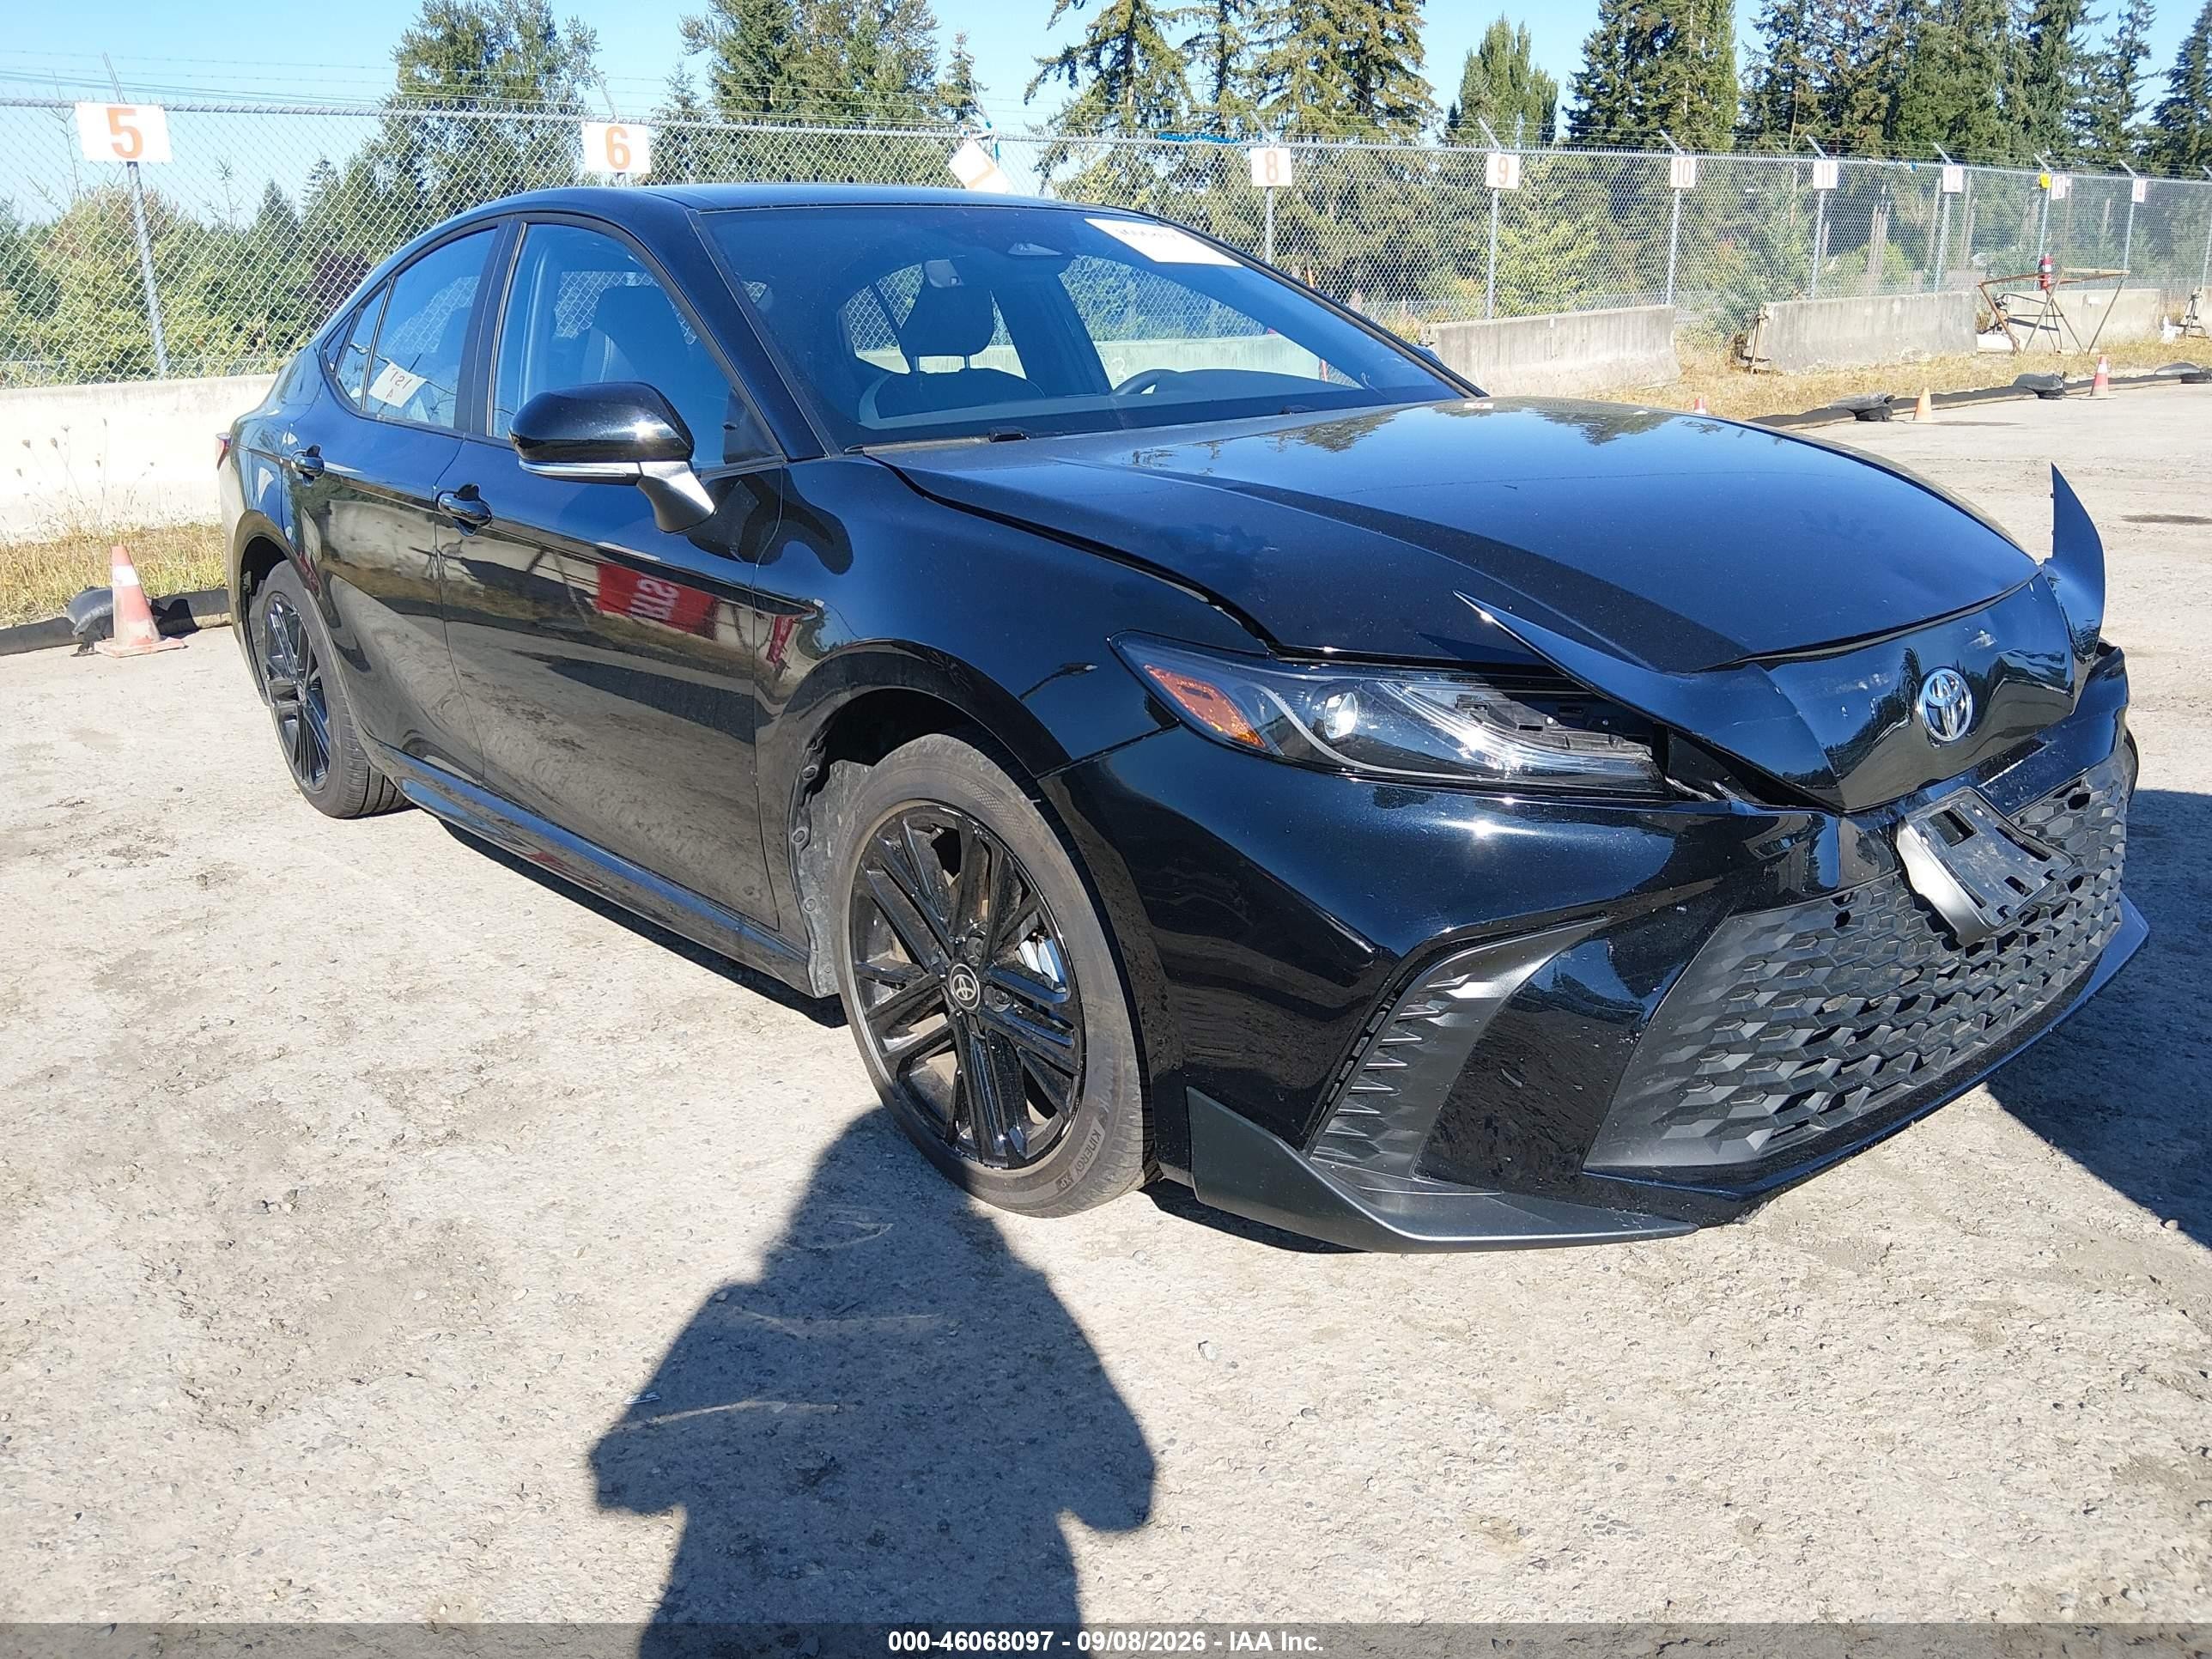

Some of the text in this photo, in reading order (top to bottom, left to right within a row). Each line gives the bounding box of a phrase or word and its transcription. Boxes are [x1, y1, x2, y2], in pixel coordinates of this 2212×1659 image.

[106, 107, 143, 159] 5
[605, 125, 631, 170] 6
[1265, 150, 1279, 184] 8
[1498, 156, 1509, 185] 9
[1677, 159, 1691, 185] 10
[1821, 164, 1831, 186] 11
[1075, 1129, 1101, 1174] KINERGY
